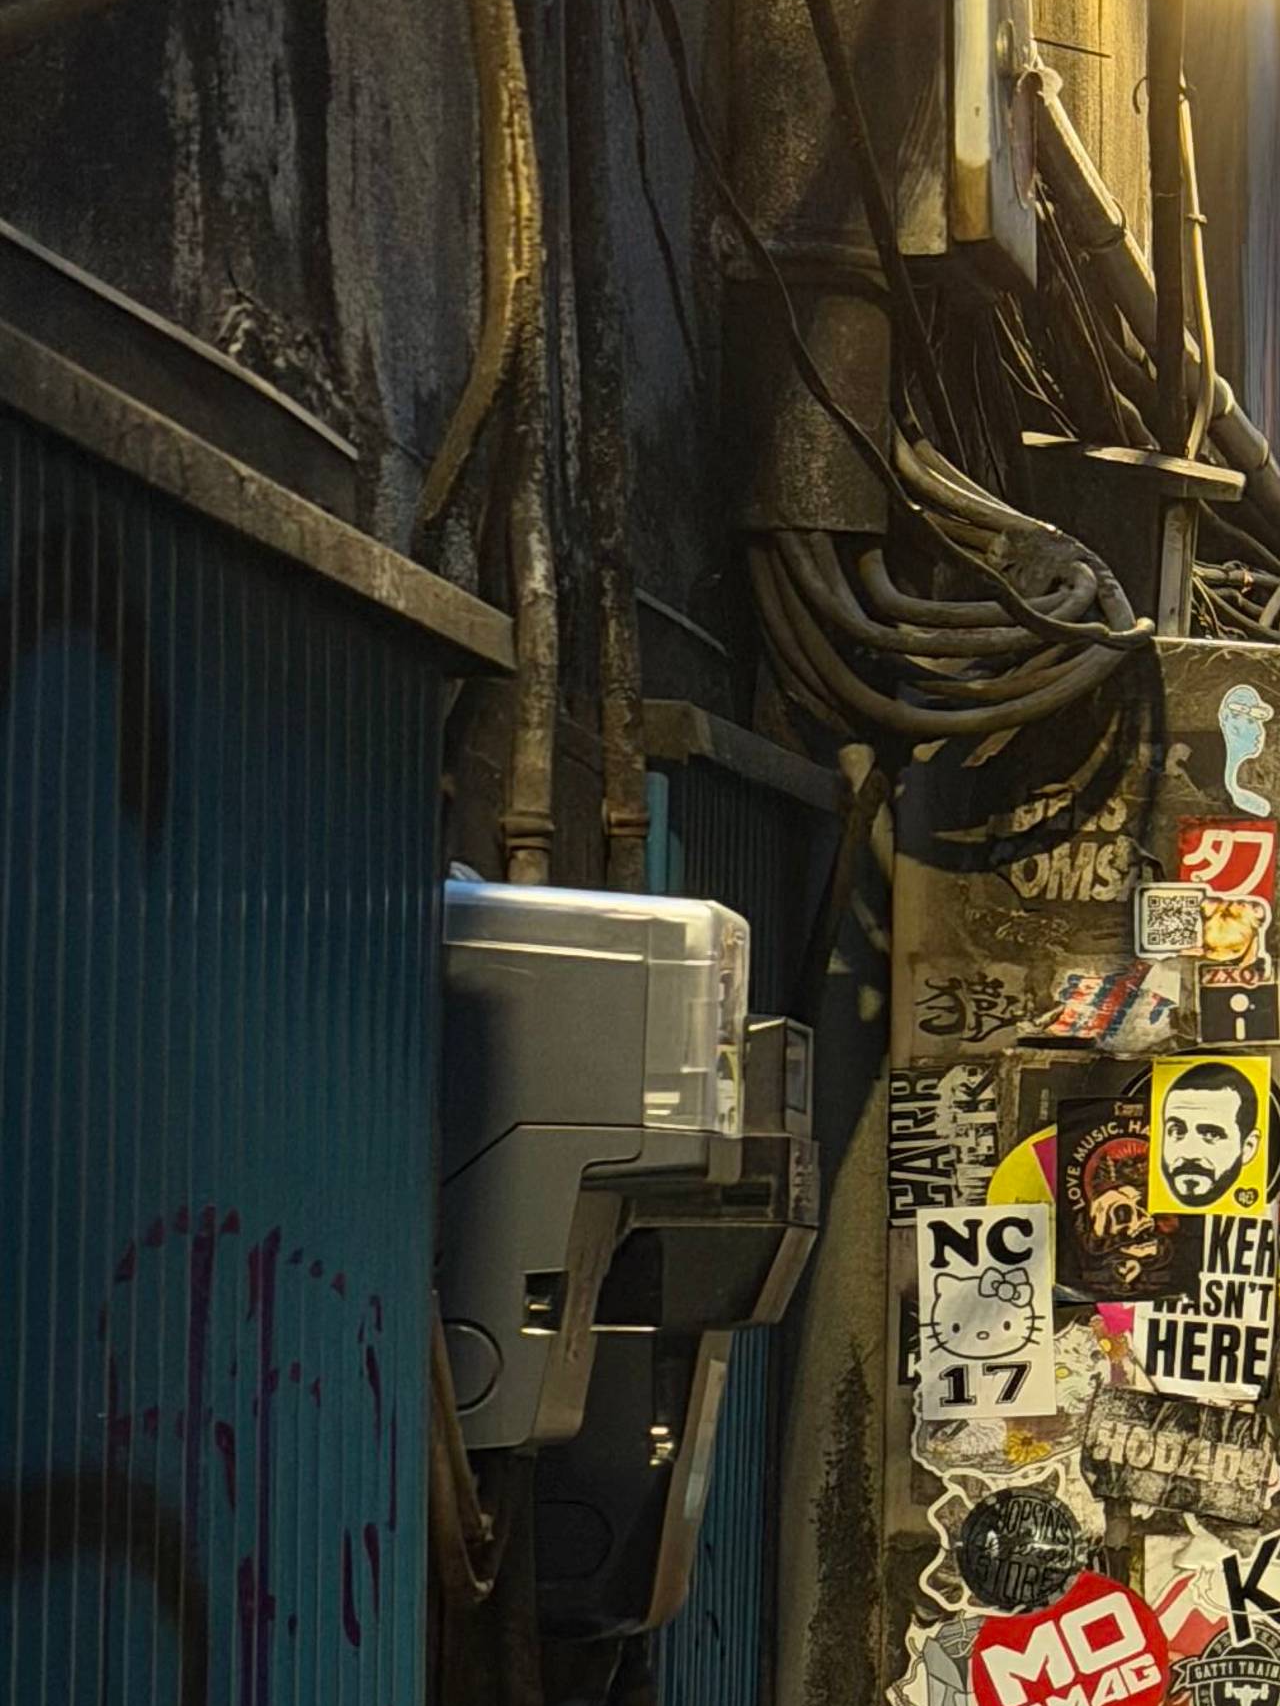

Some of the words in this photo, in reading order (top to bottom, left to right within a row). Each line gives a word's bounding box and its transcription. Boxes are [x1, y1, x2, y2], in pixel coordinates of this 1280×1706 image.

[1075, 1120, 1124, 1163] MUSIC.
[1066, 1165, 1086, 1211] LOVE
[926, 1216, 1034, 1269] NC
[1145, 1318, 1270, 1386] HERE
[939, 1361, 1032, 1408] 17
